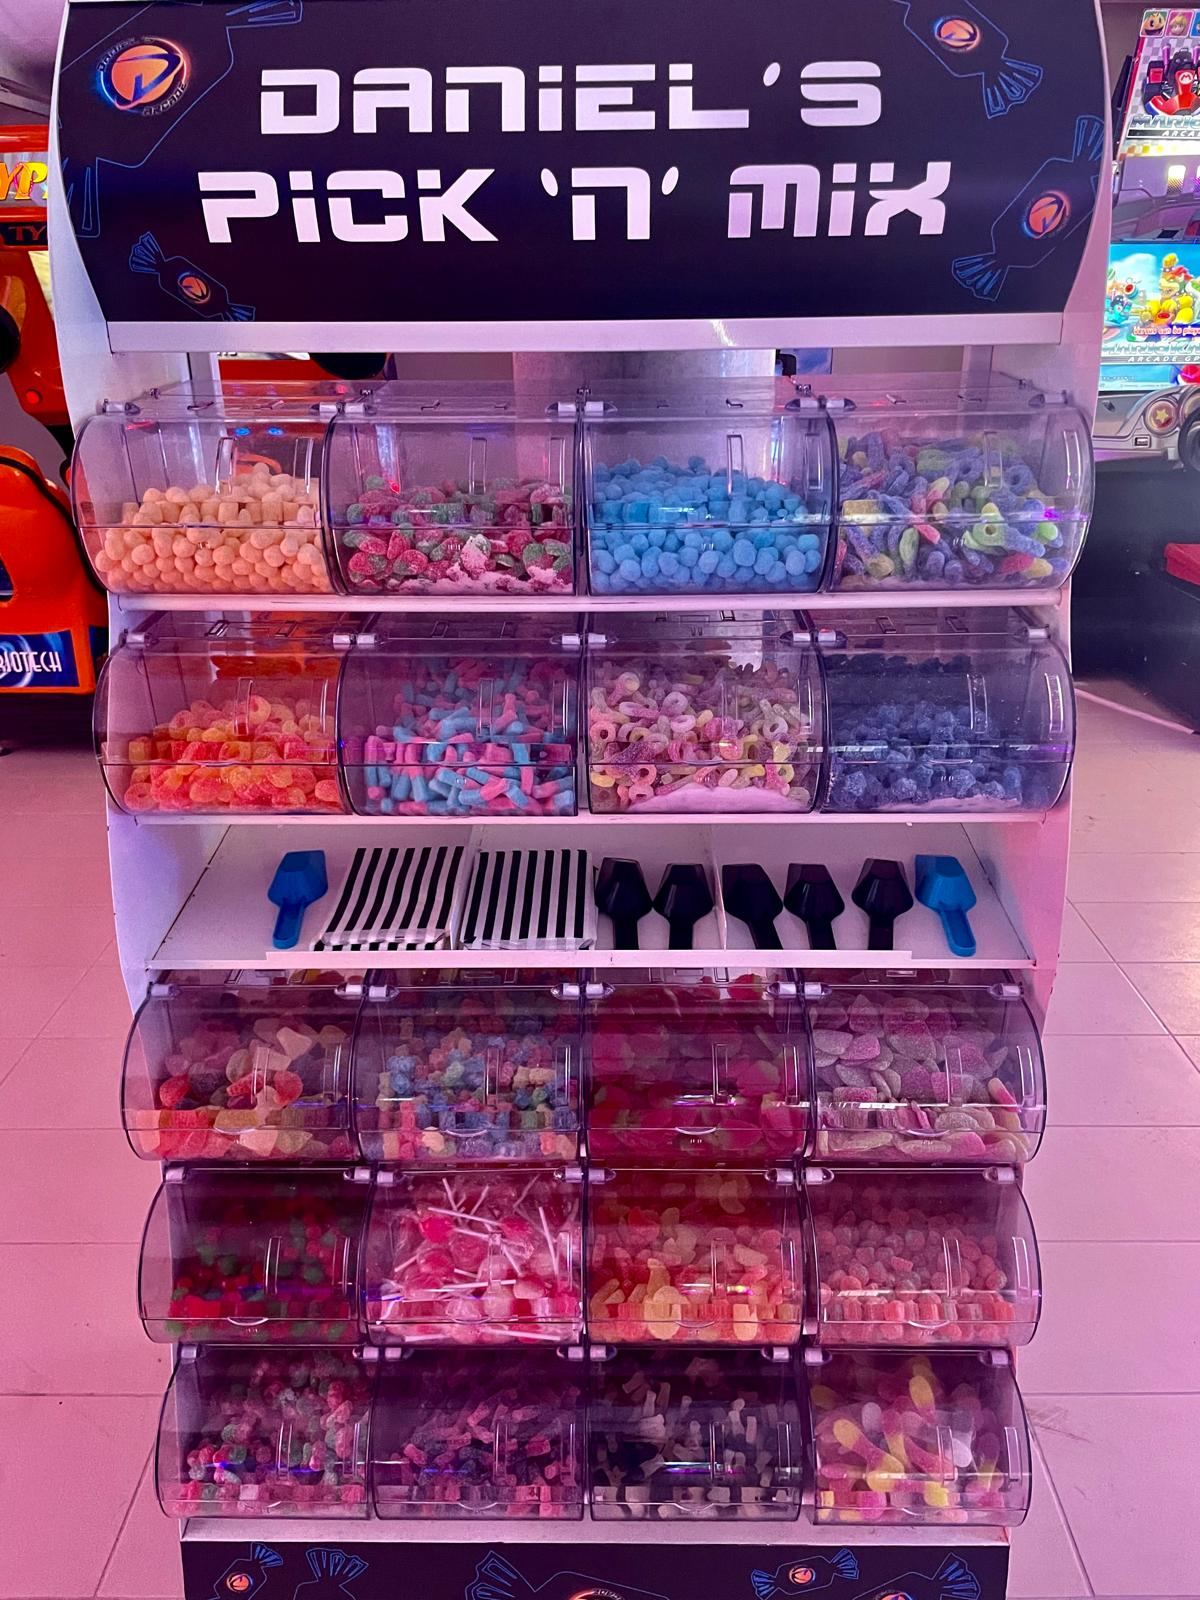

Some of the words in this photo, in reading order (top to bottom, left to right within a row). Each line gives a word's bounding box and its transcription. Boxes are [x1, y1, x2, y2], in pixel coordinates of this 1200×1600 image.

[260, 60, 882, 134] DANIEL'S
[197, 168, 499, 243] PICK
[727, 161, 952, 238] MIX
